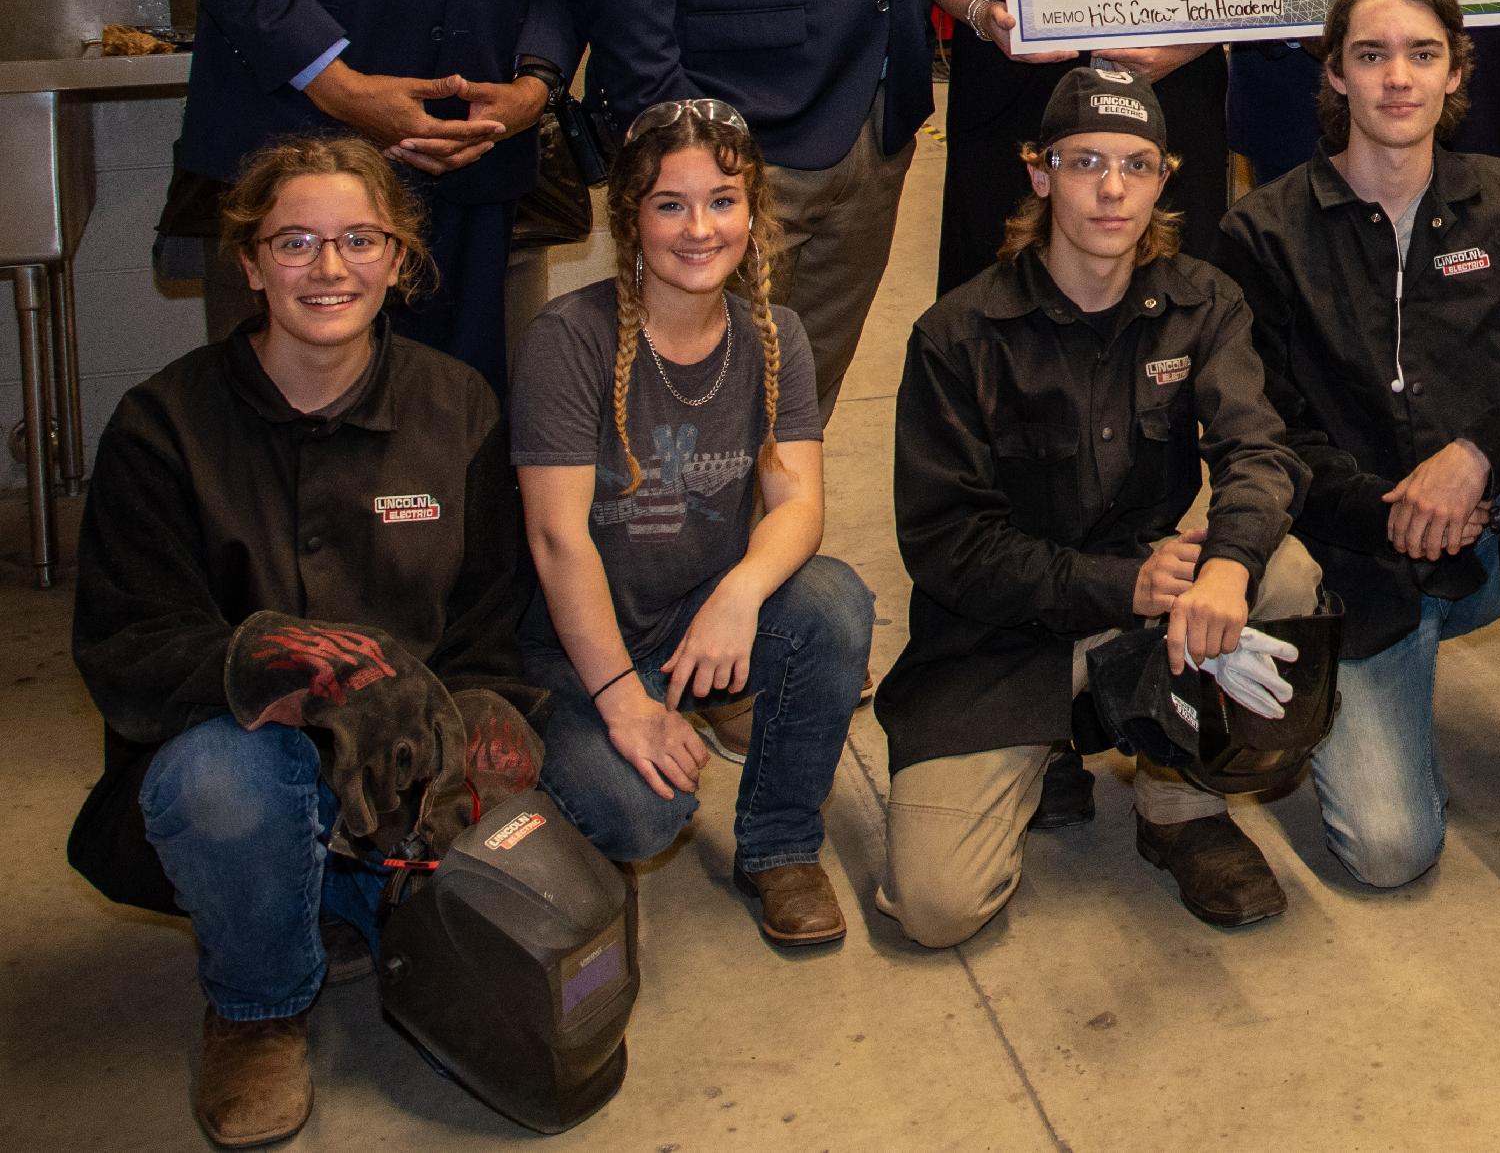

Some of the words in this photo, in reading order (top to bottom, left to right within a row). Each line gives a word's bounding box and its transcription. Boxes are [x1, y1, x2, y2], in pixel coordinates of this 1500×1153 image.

[1042, 10, 1085, 25] MEMO
[1093, 96, 1140, 109] LINCOLN
[1104, 107, 1144, 119] ELECTRIC
[1437, 250, 1478, 267] LINCOLN
[1448, 259, 1485, 273] ELECTRIC
[1149, 356, 1188, 374] LINCOL
[377, 497, 427, 510] LINCOLN
[389, 508, 433, 520] ELECTRIC
[488, 815, 530, 846] LINCOLN
